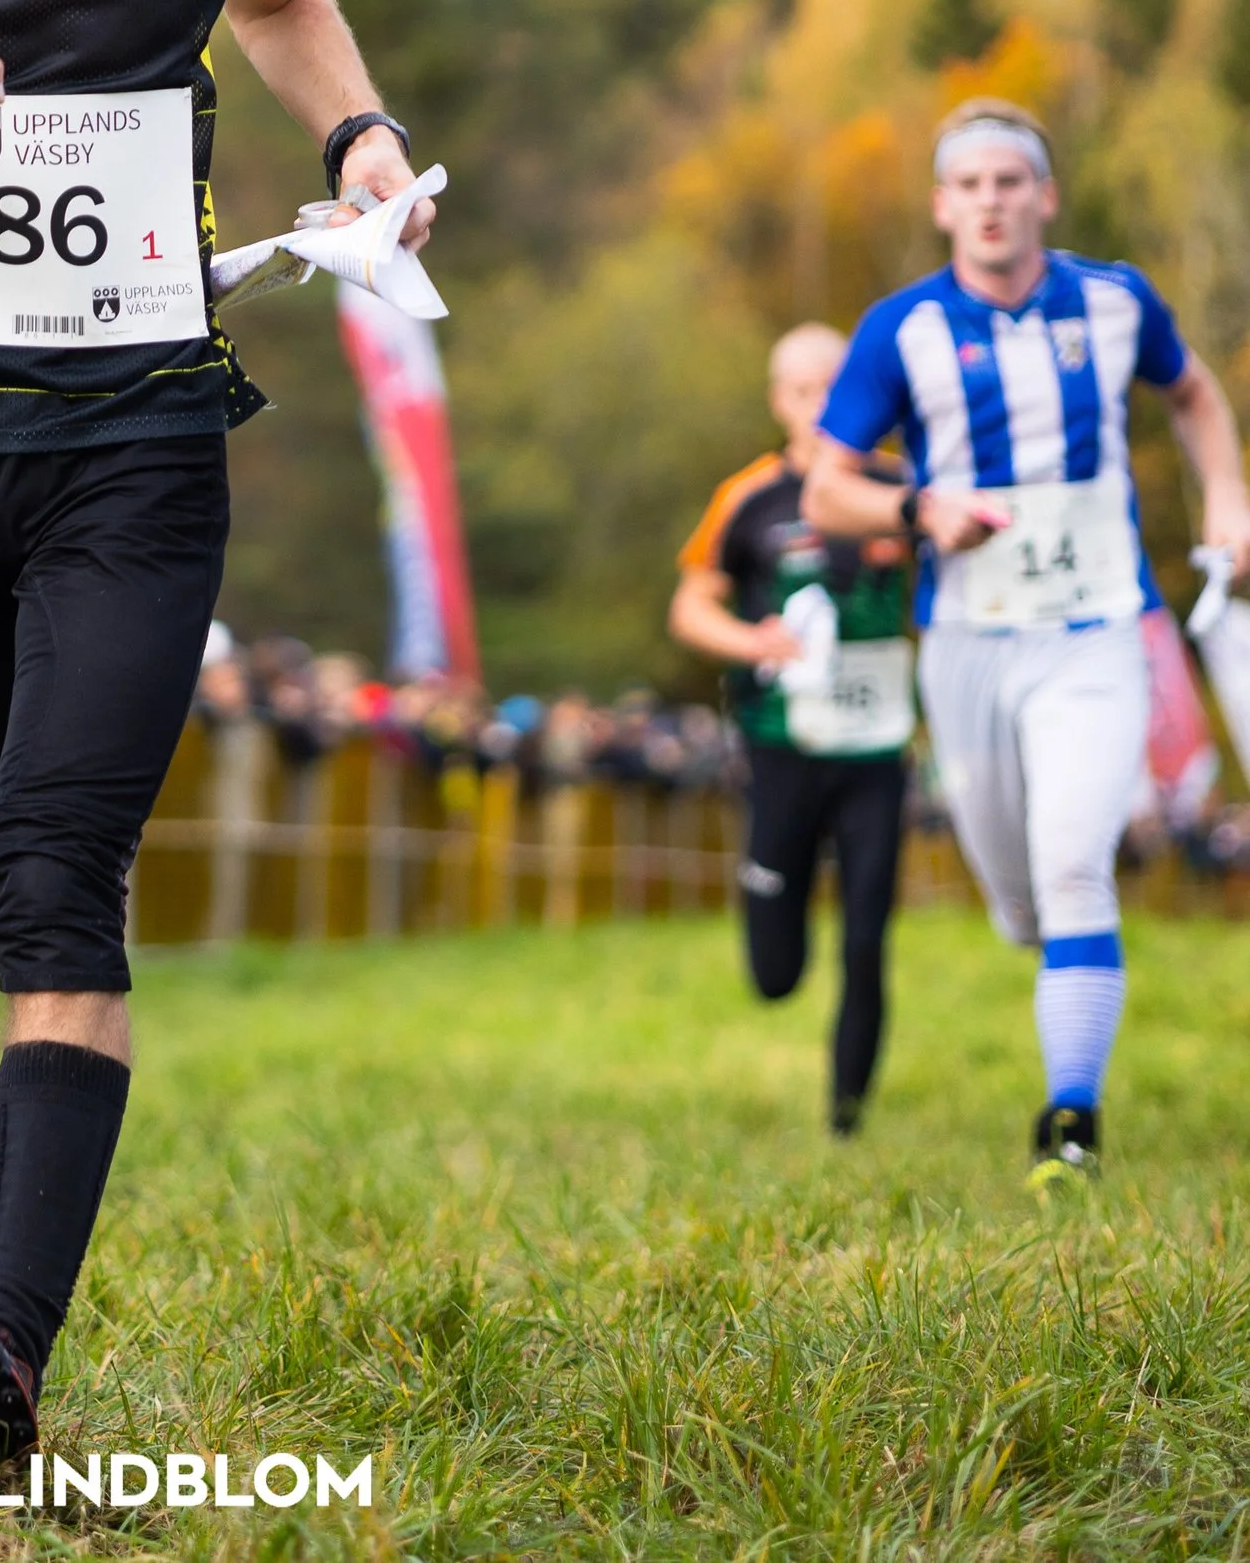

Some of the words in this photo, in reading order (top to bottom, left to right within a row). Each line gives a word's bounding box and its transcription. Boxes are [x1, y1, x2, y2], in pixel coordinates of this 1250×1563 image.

[12, 109, 142, 135] UPPLANDS
[14, 140, 95, 166] VÄSBY
[142, 230, 163, 260] 1
[124, 283, 194, 300] UPPLANDS
[126, 301, 168, 316] VÄSBY
[1015, 531, 1077, 578] 14
